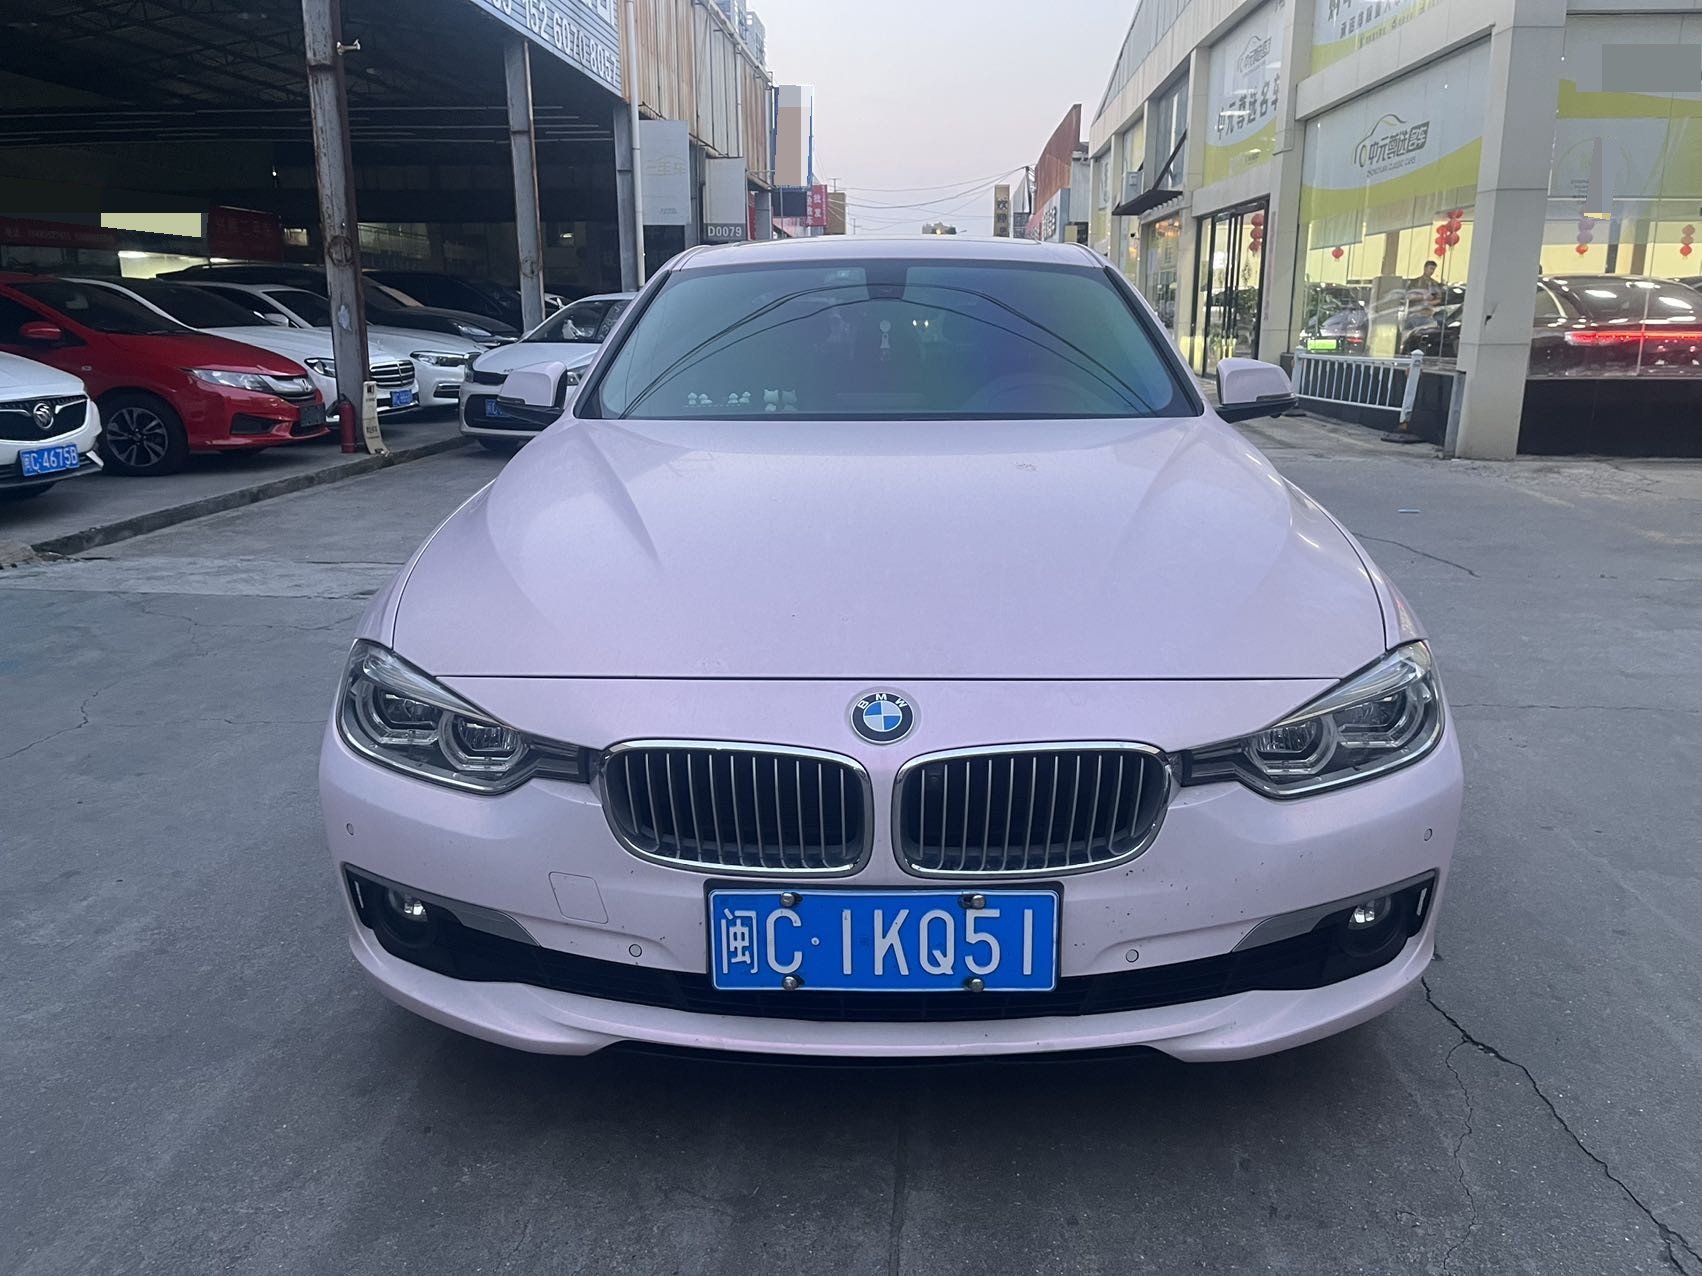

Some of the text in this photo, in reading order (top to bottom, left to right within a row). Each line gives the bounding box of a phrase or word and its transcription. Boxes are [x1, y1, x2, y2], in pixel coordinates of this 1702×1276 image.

[553, 11, 587, 62] 6070
[589, 39, 617, 86] 8057
[708, 226, 742, 238] D0079
[857, 693, 908, 710] BMW
[720, 908, 1034, 976] 闽C·1KQ51
